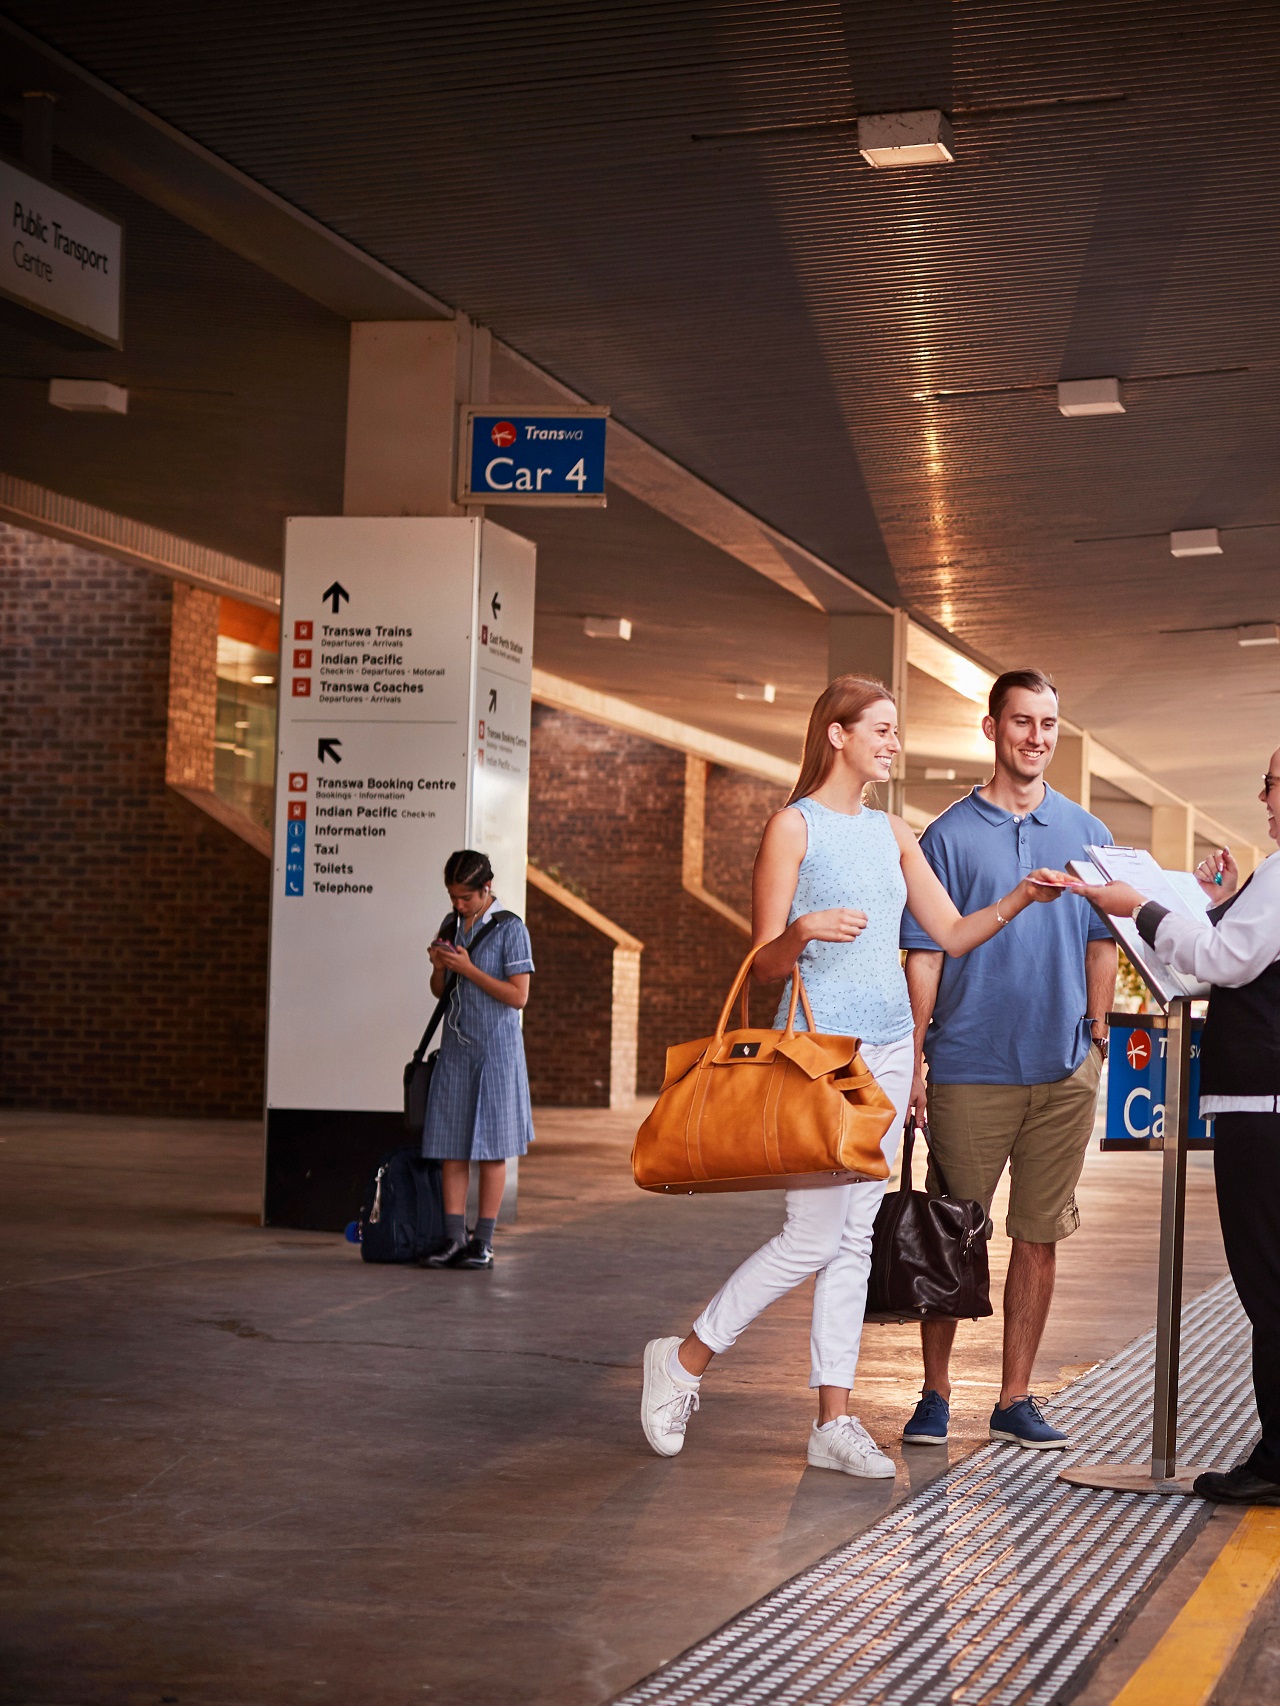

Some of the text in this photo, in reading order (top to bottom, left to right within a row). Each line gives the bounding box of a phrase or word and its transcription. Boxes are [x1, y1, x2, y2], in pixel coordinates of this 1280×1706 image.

[12, 200, 109, 275] Public Transport
[12, 240, 53, 283] Centre
[524, 425, 584, 441] Transwa
[484, 456, 587, 492] Car 4
[322, 625, 413, 638] Transwa Trains
[320, 639, 403, 648] Departures Arrivals
[320, 653, 403, 666] Indian Pacific
[319, 667, 445, 677] Check-in Departures Motorail
[319, 681, 424, 694] Transwa Coaches
[319, 695, 402, 704] Departures Arrivals
[316, 777, 456, 792] Transwa Booking Centre
[315, 791, 405, 801] Bookings Information
[315, 805, 436, 819] Indian Pacific Check-in
[314, 824, 387, 838] Information
[314, 843, 339, 856] Taxi
[313, 862, 354, 875] Toilets
[312, 881, 373, 895] Telephone
[1123, 1086, 1165, 1139] Ca
